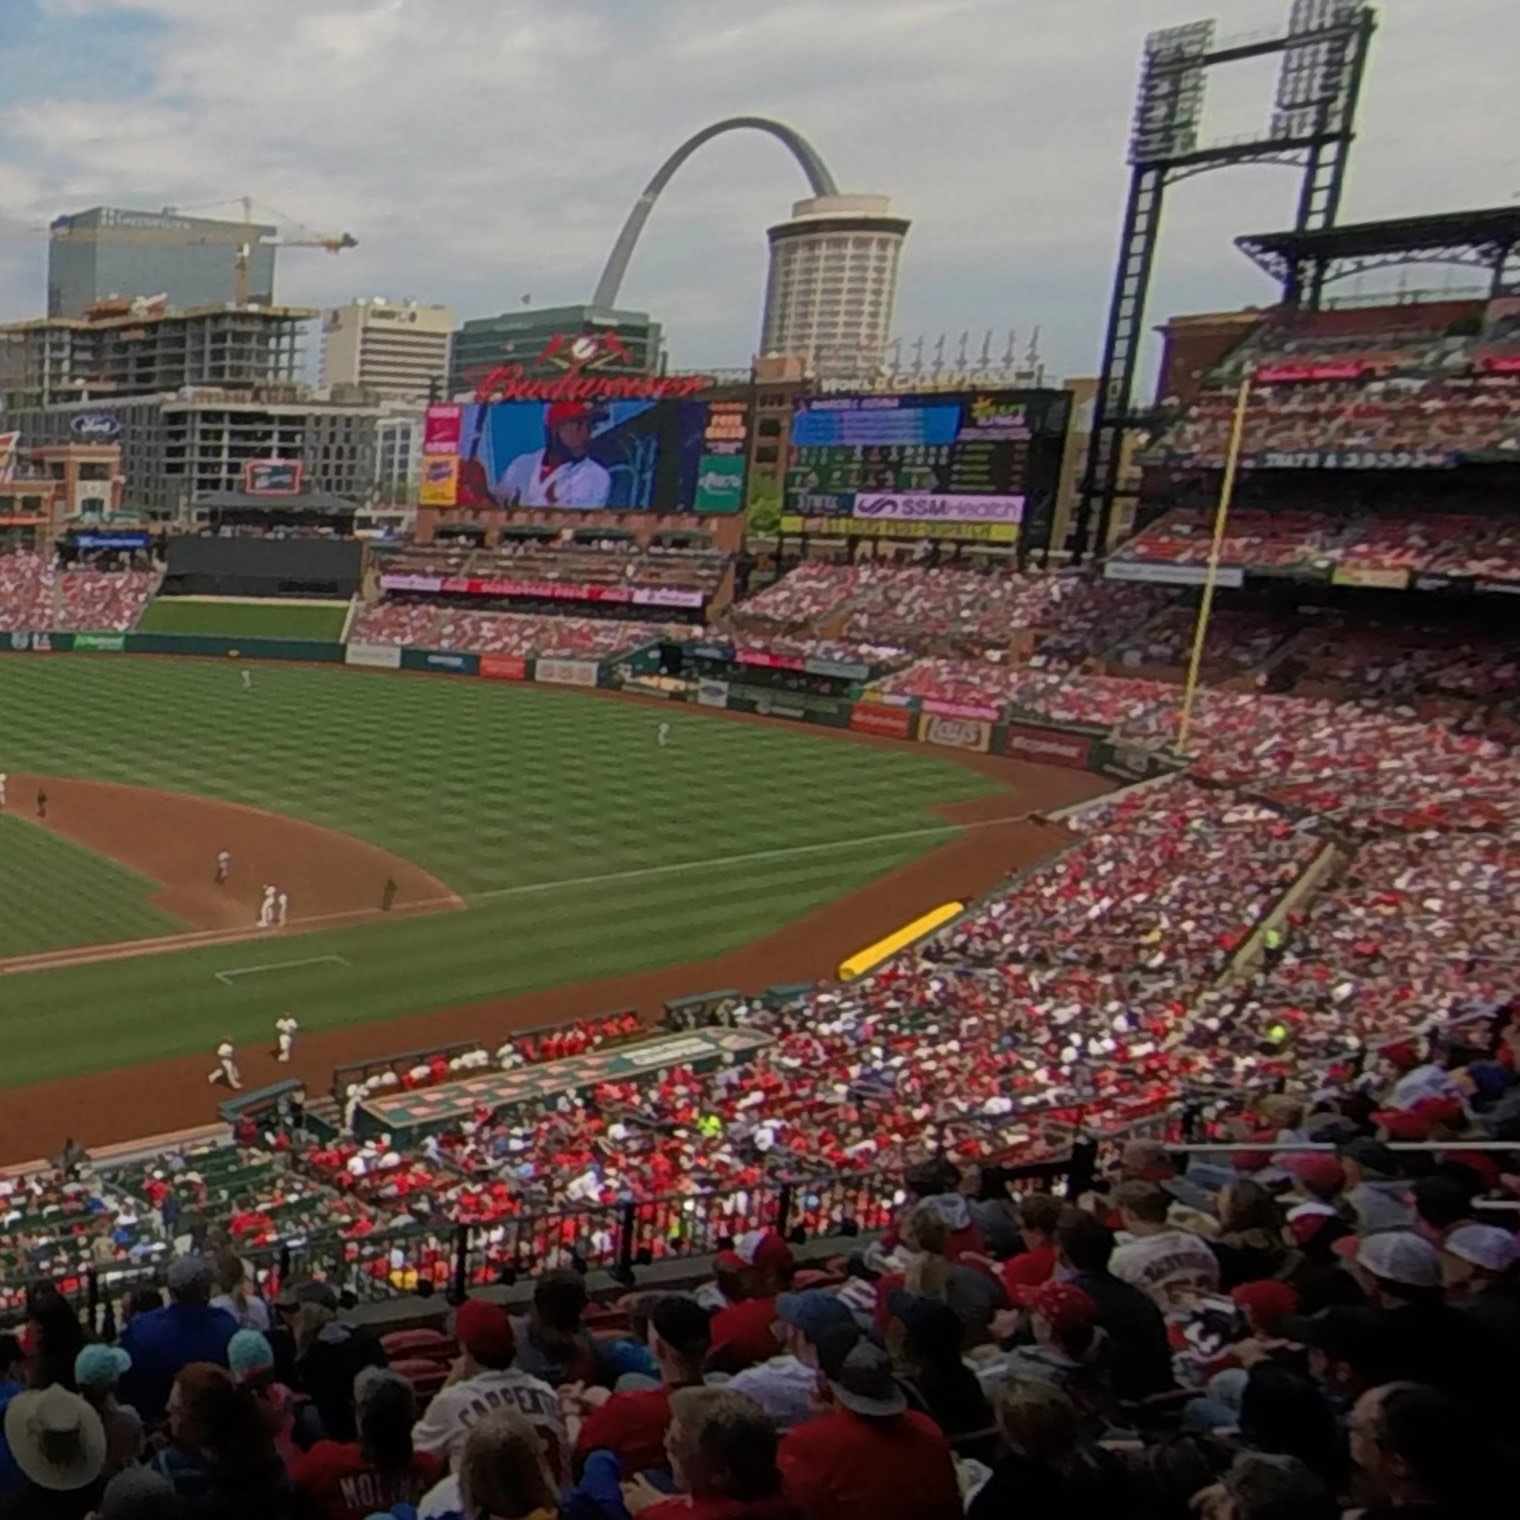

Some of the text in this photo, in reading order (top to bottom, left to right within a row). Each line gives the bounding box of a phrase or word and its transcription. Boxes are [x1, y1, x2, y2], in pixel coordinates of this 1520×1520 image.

[470, 365, 706, 401] Budweiser
[821, 371, 1017, 394] WORLD CHAMPIONS
[81, 417, 112, 432] Ford
